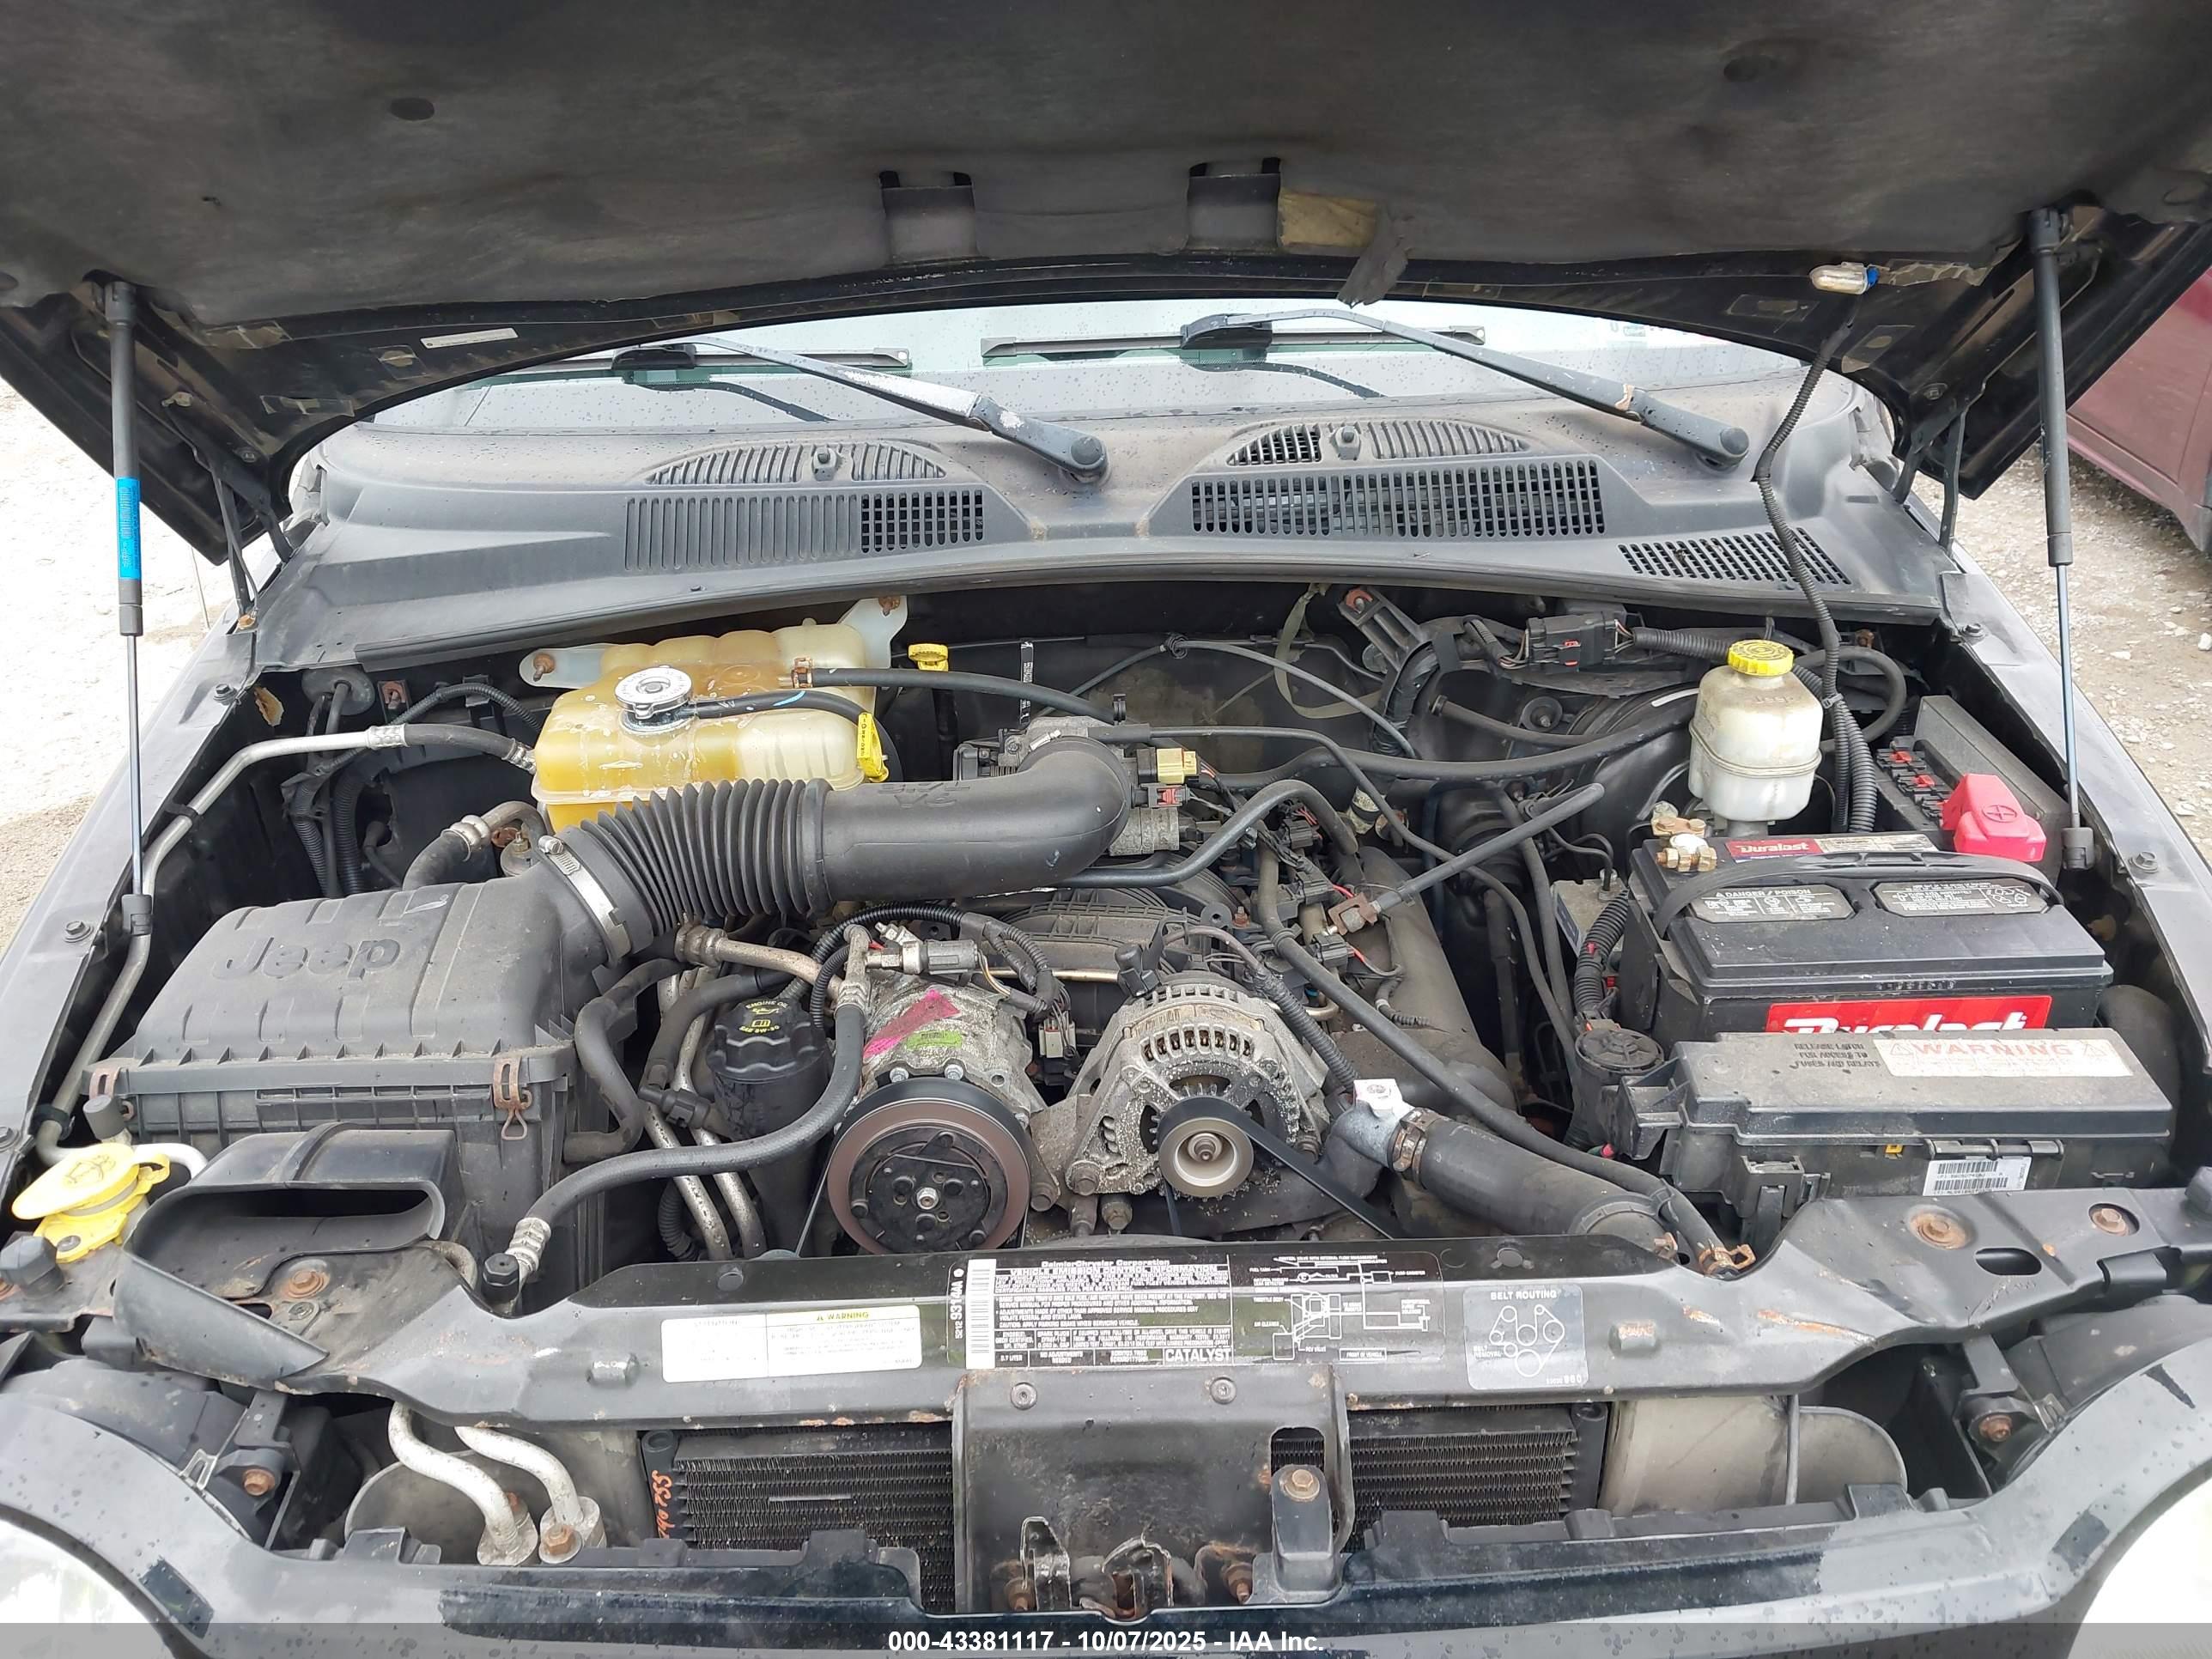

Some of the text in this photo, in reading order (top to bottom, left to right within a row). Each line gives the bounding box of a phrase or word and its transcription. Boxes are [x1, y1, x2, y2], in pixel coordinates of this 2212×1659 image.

[1736, 842, 1808, 854] Duralast
[212, 937, 400, 980] Jeep
[745, 1000, 777, 1009] ENGINE
[1913, 1043, 2073, 1056] WARNING
[1041, 1260, 1115, 1268] DaimlerChrysler
[1490, 1290, 1558, 1301] BELT ROUTING
[827, 1311, 870, 1321] WARNING
[1165, 1347, 1231, 1362] CATALYST
